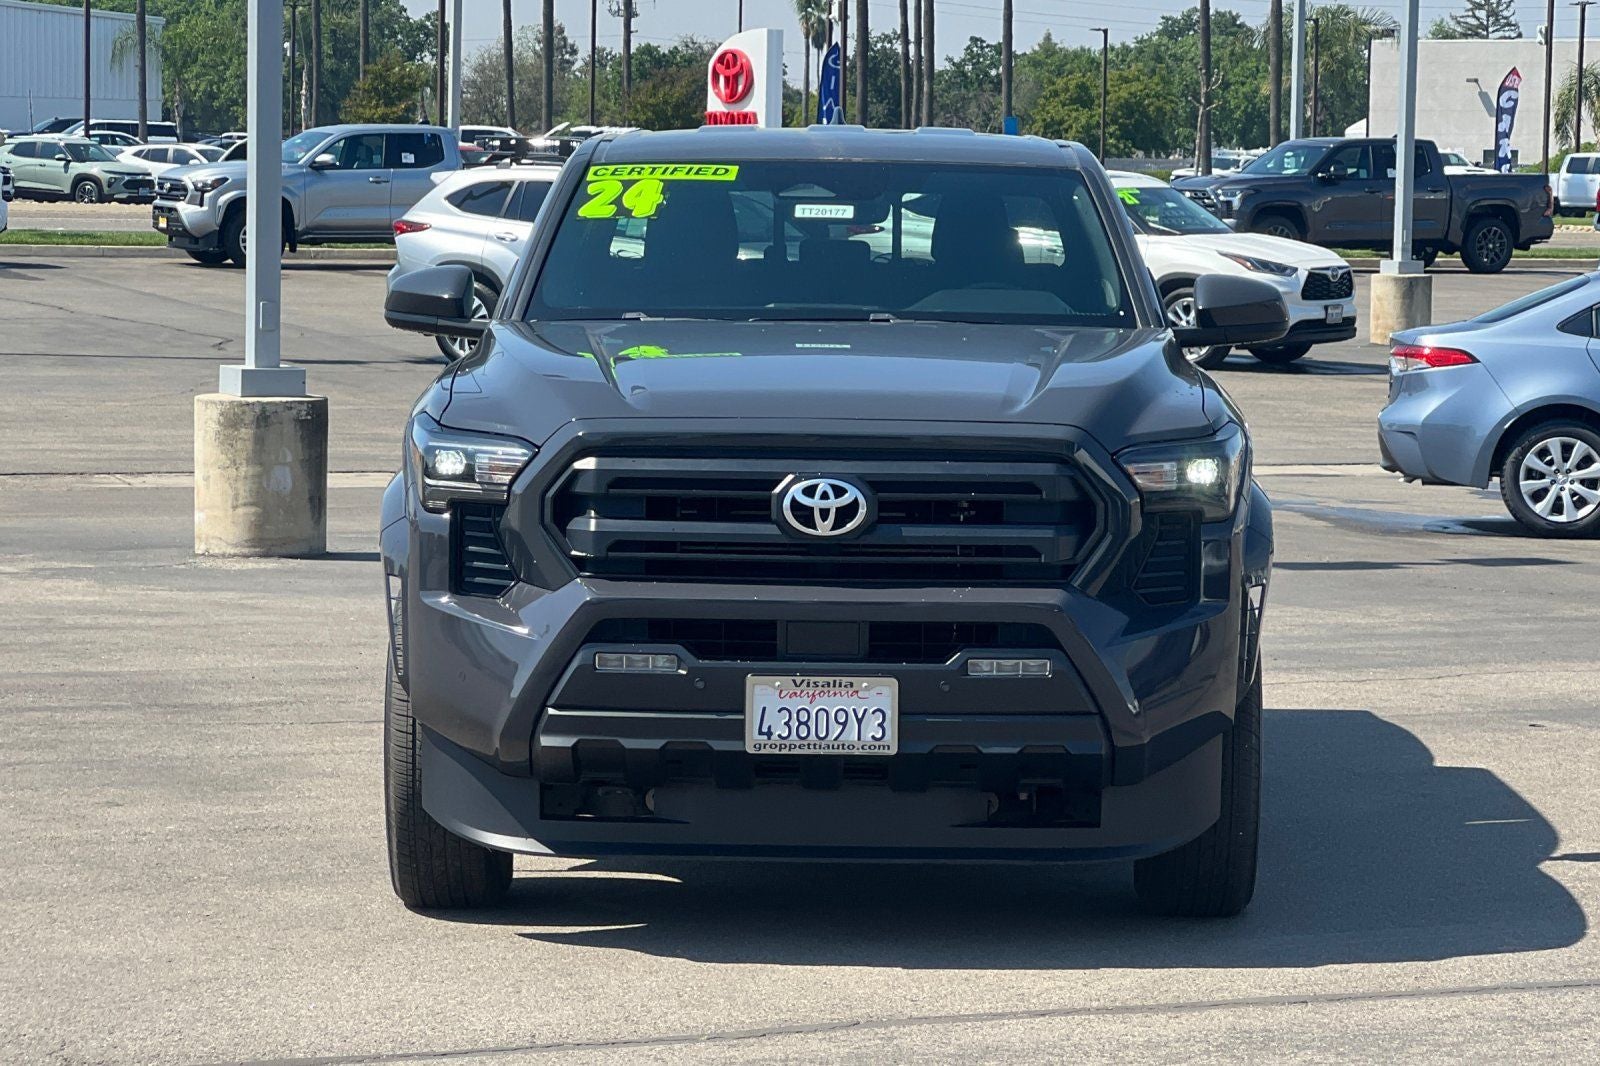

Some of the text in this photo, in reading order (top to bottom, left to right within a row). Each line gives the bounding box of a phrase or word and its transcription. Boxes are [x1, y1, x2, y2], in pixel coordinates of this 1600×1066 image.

[704, 111, 758, 125] TOYOTA
[592, 166, 730, 177] CERTIFIED
[577, 178, 664, 218] 24
[800, 207, 847, 217] TT20177
[792, 679, 854, 688] Visalia
[778, 690, 870, 705] California
[757, 706, 887, 741] 43809Y3
[753, 742, 891, 752] groppettiauto.com
